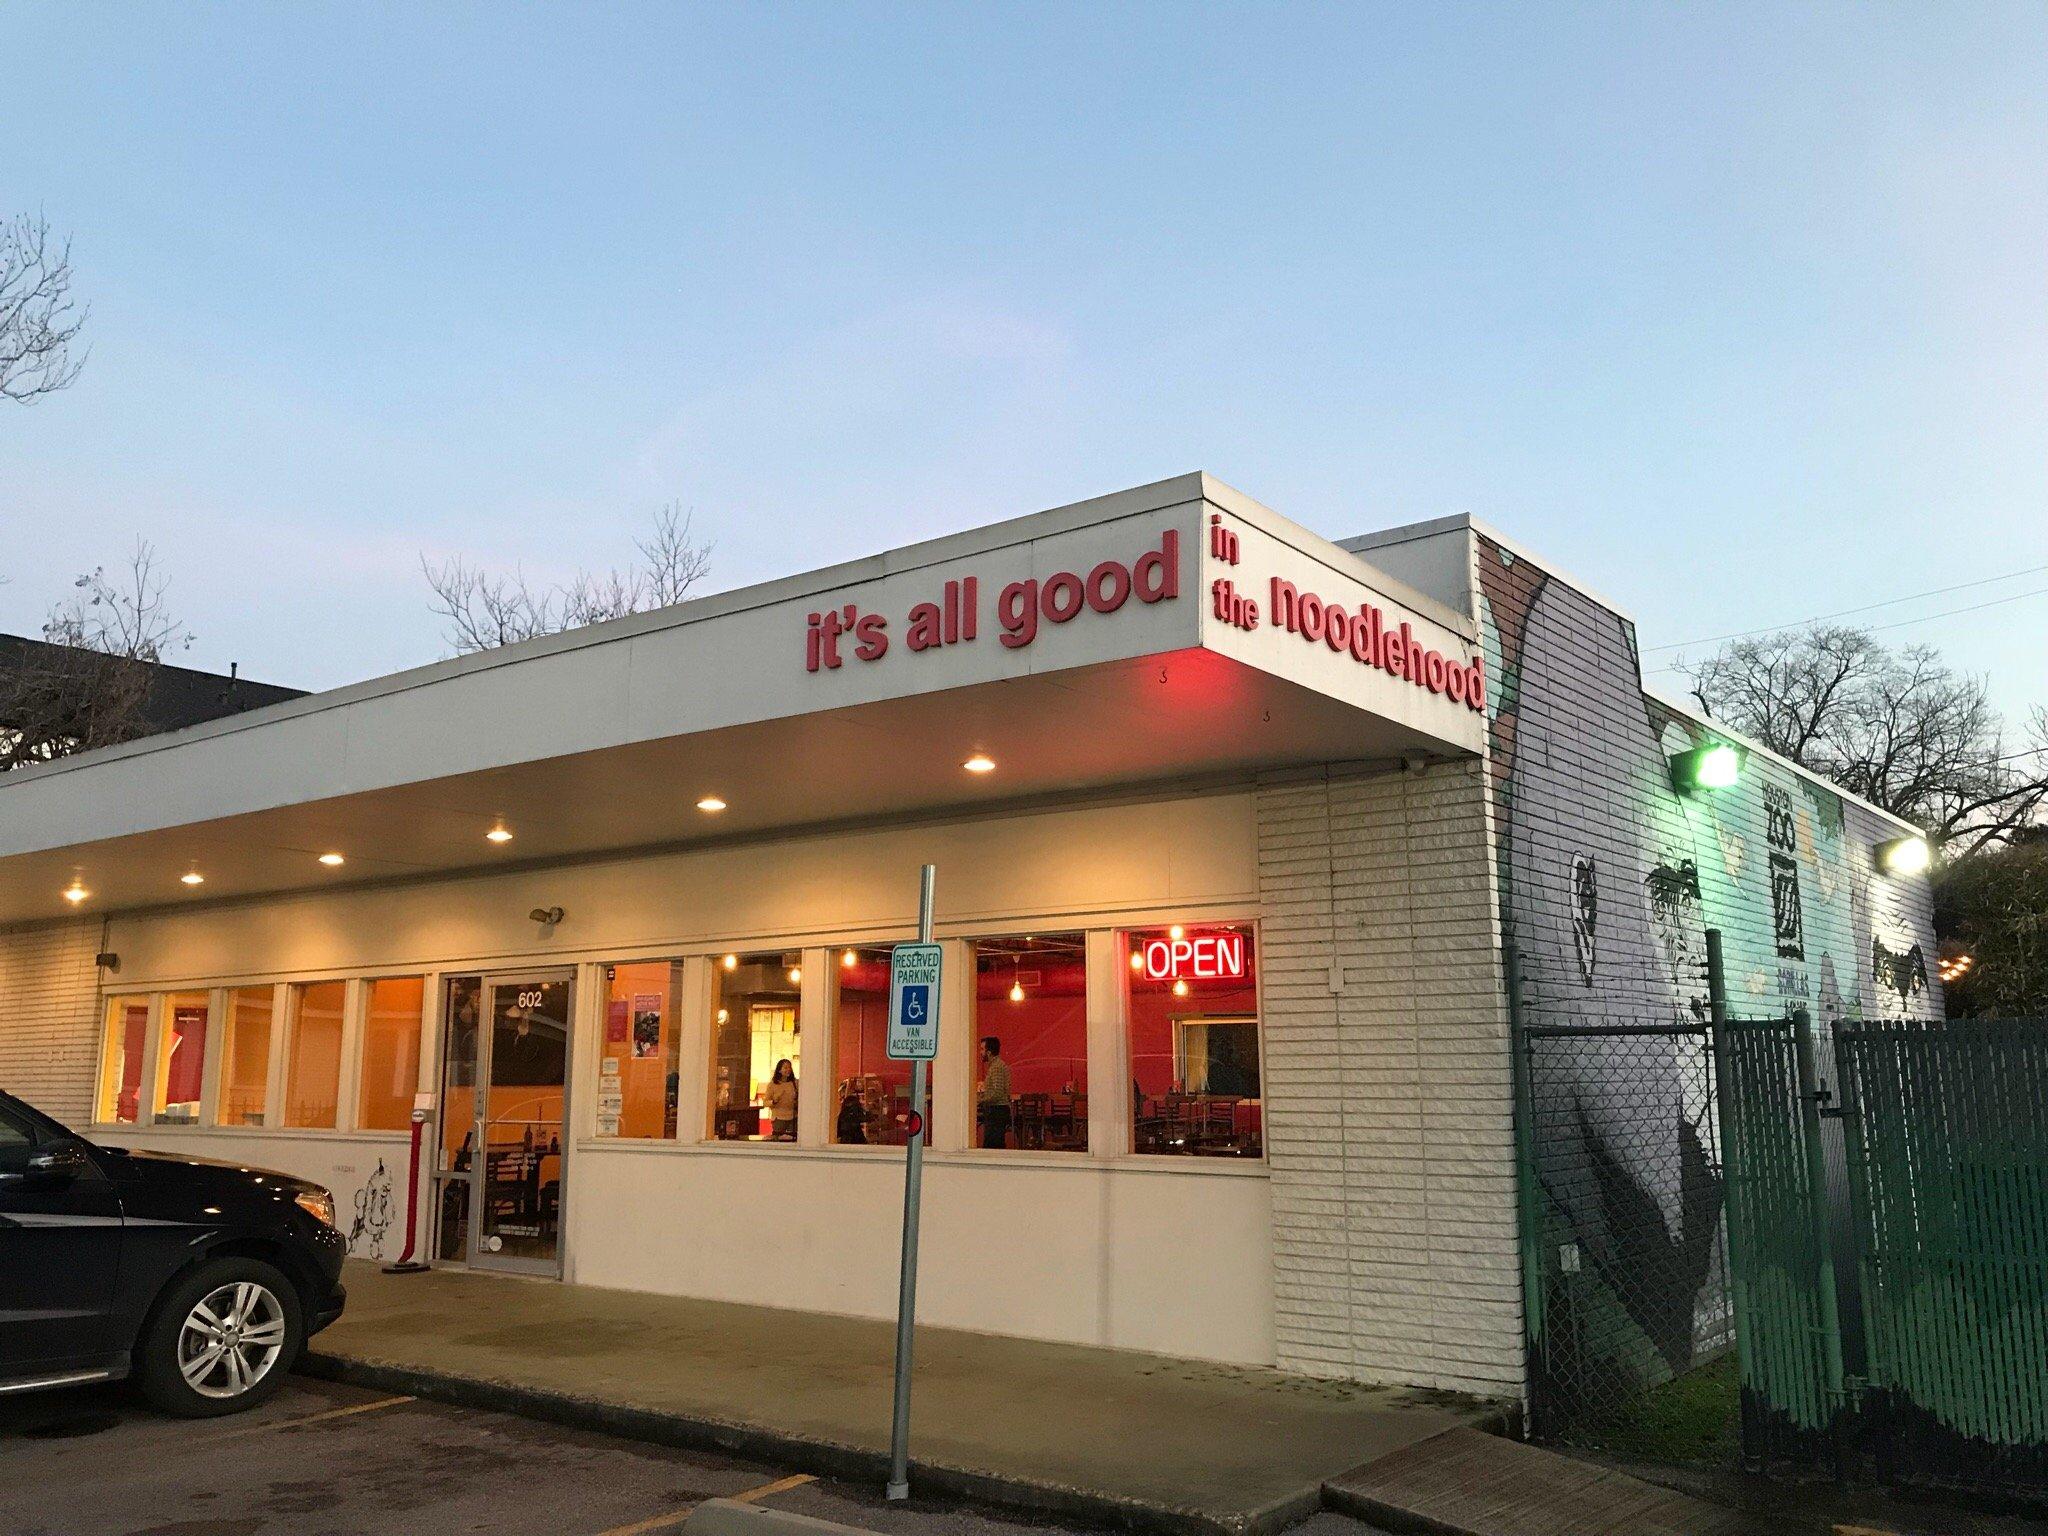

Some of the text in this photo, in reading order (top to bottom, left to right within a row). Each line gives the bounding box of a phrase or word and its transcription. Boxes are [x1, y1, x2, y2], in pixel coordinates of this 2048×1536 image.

[1211, 514, 1240, 565] in
[806, 529, 1179, 672] it's all good
[1212, 577, 1486, 711] the noodlehood
[896, 953, 939, 968] RESERVED
[1147, 938, 1240, 977] OPEN
[897, 969, 935, 983] PARKING
[518, 991, 542, 1008] 602
[906, 1027, 920, 1037] VAN
[892, 1039, 933, 1050] ACCESSIBLE
